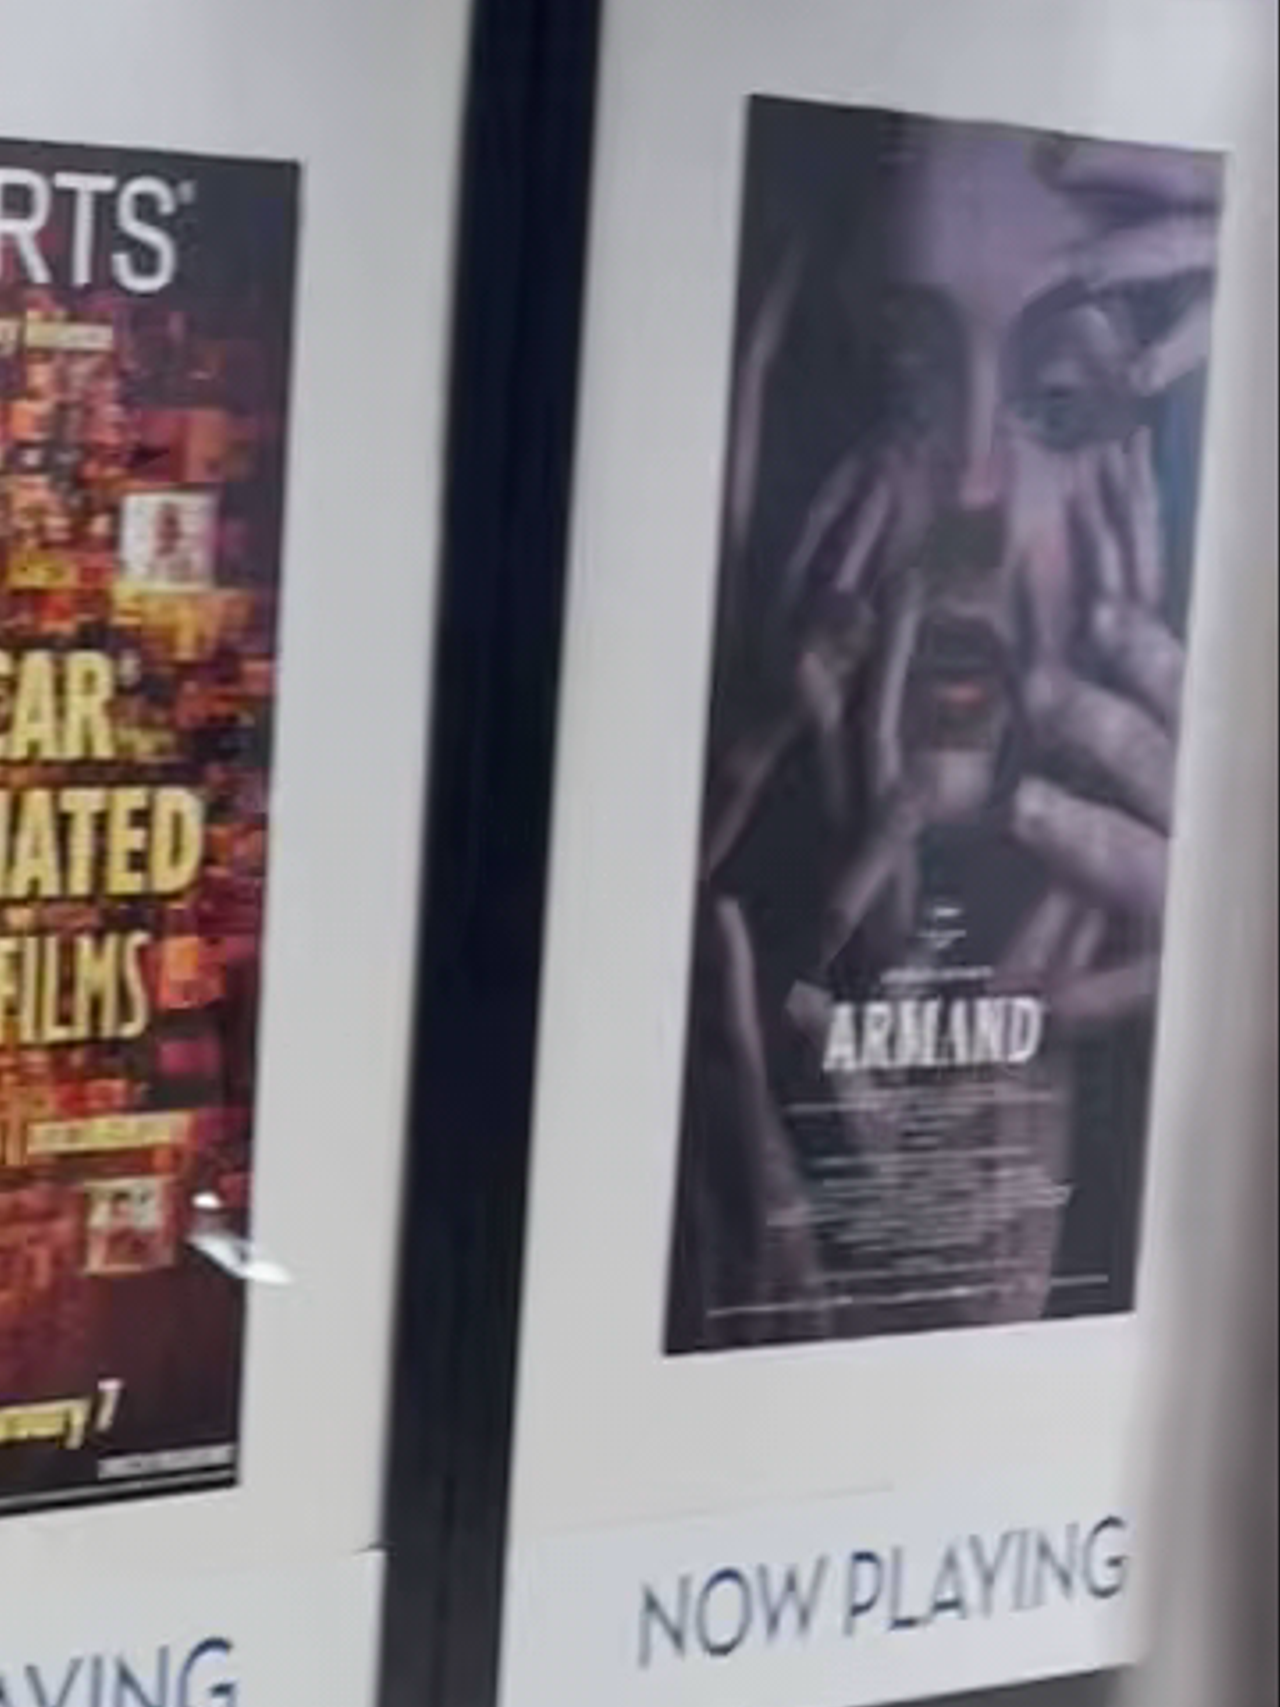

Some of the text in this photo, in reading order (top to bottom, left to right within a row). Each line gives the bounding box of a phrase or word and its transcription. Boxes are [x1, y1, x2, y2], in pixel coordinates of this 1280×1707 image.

[823, 997, 1043, 1071] ARMAND
[97, 1378, 123, 1432] 7
[639, 1516, 1129, 1668] NOW PLAYING
